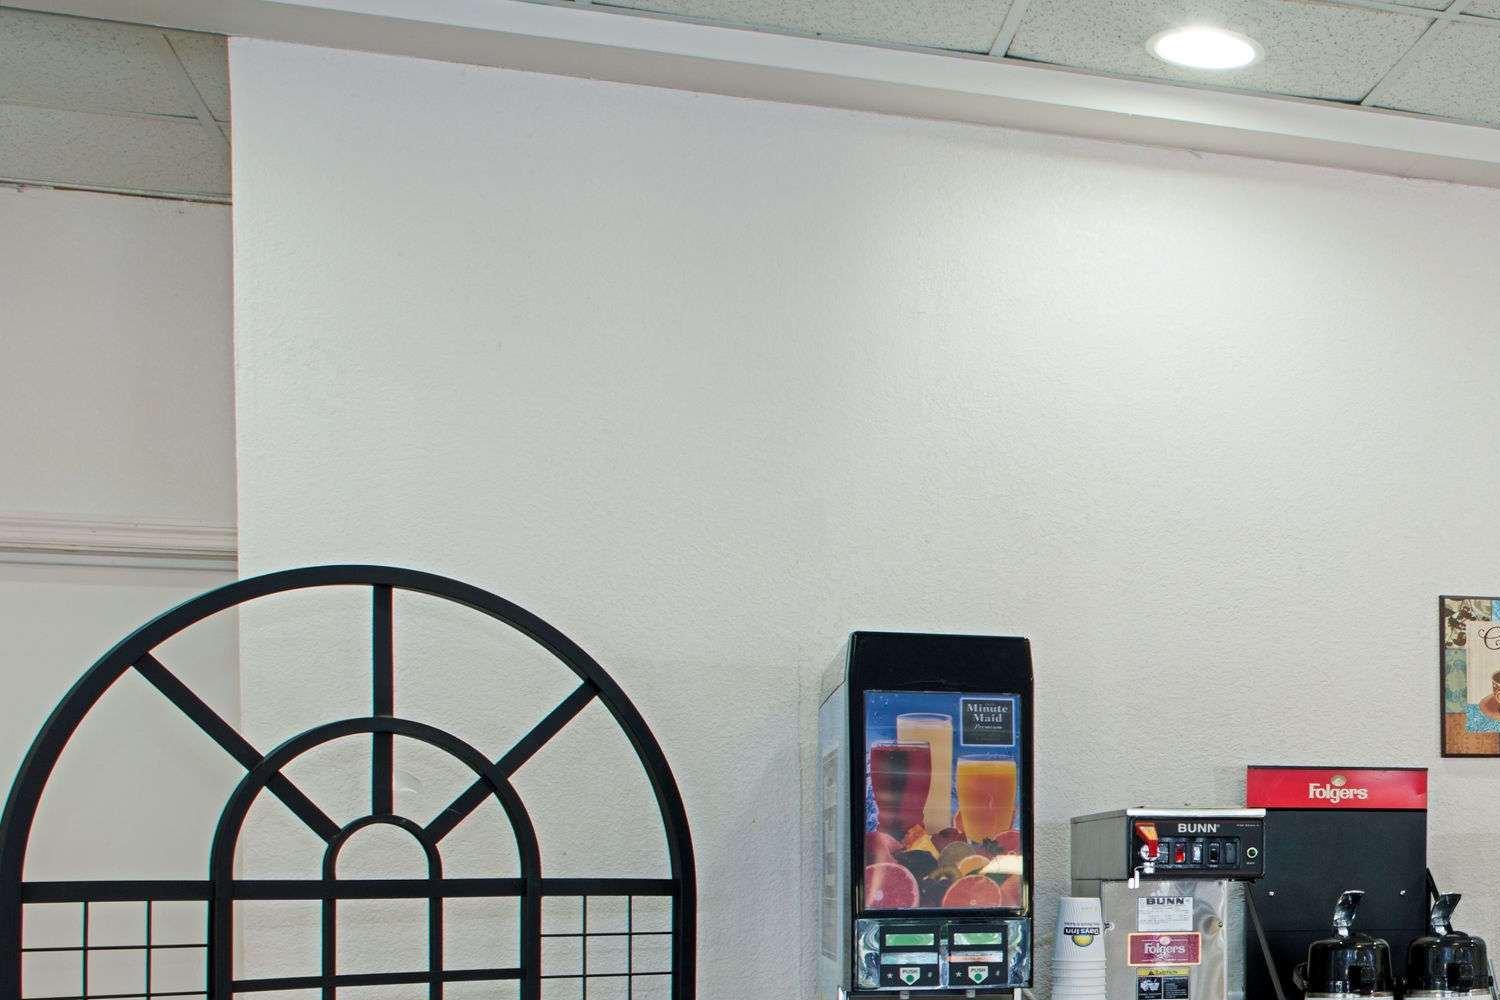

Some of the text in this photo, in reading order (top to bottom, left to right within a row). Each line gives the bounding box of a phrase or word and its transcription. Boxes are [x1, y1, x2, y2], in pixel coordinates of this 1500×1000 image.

[967, 703, 1009, 713] Minute
[974, 713, 1003, 723] Maid
[1308, 783, 1369, 804] Folgers
[1177, 823, 1218, 833] BUNN
[1146, 897, 1185, 905] BUNN
[1144, 942, 1186, 956] Folgers
